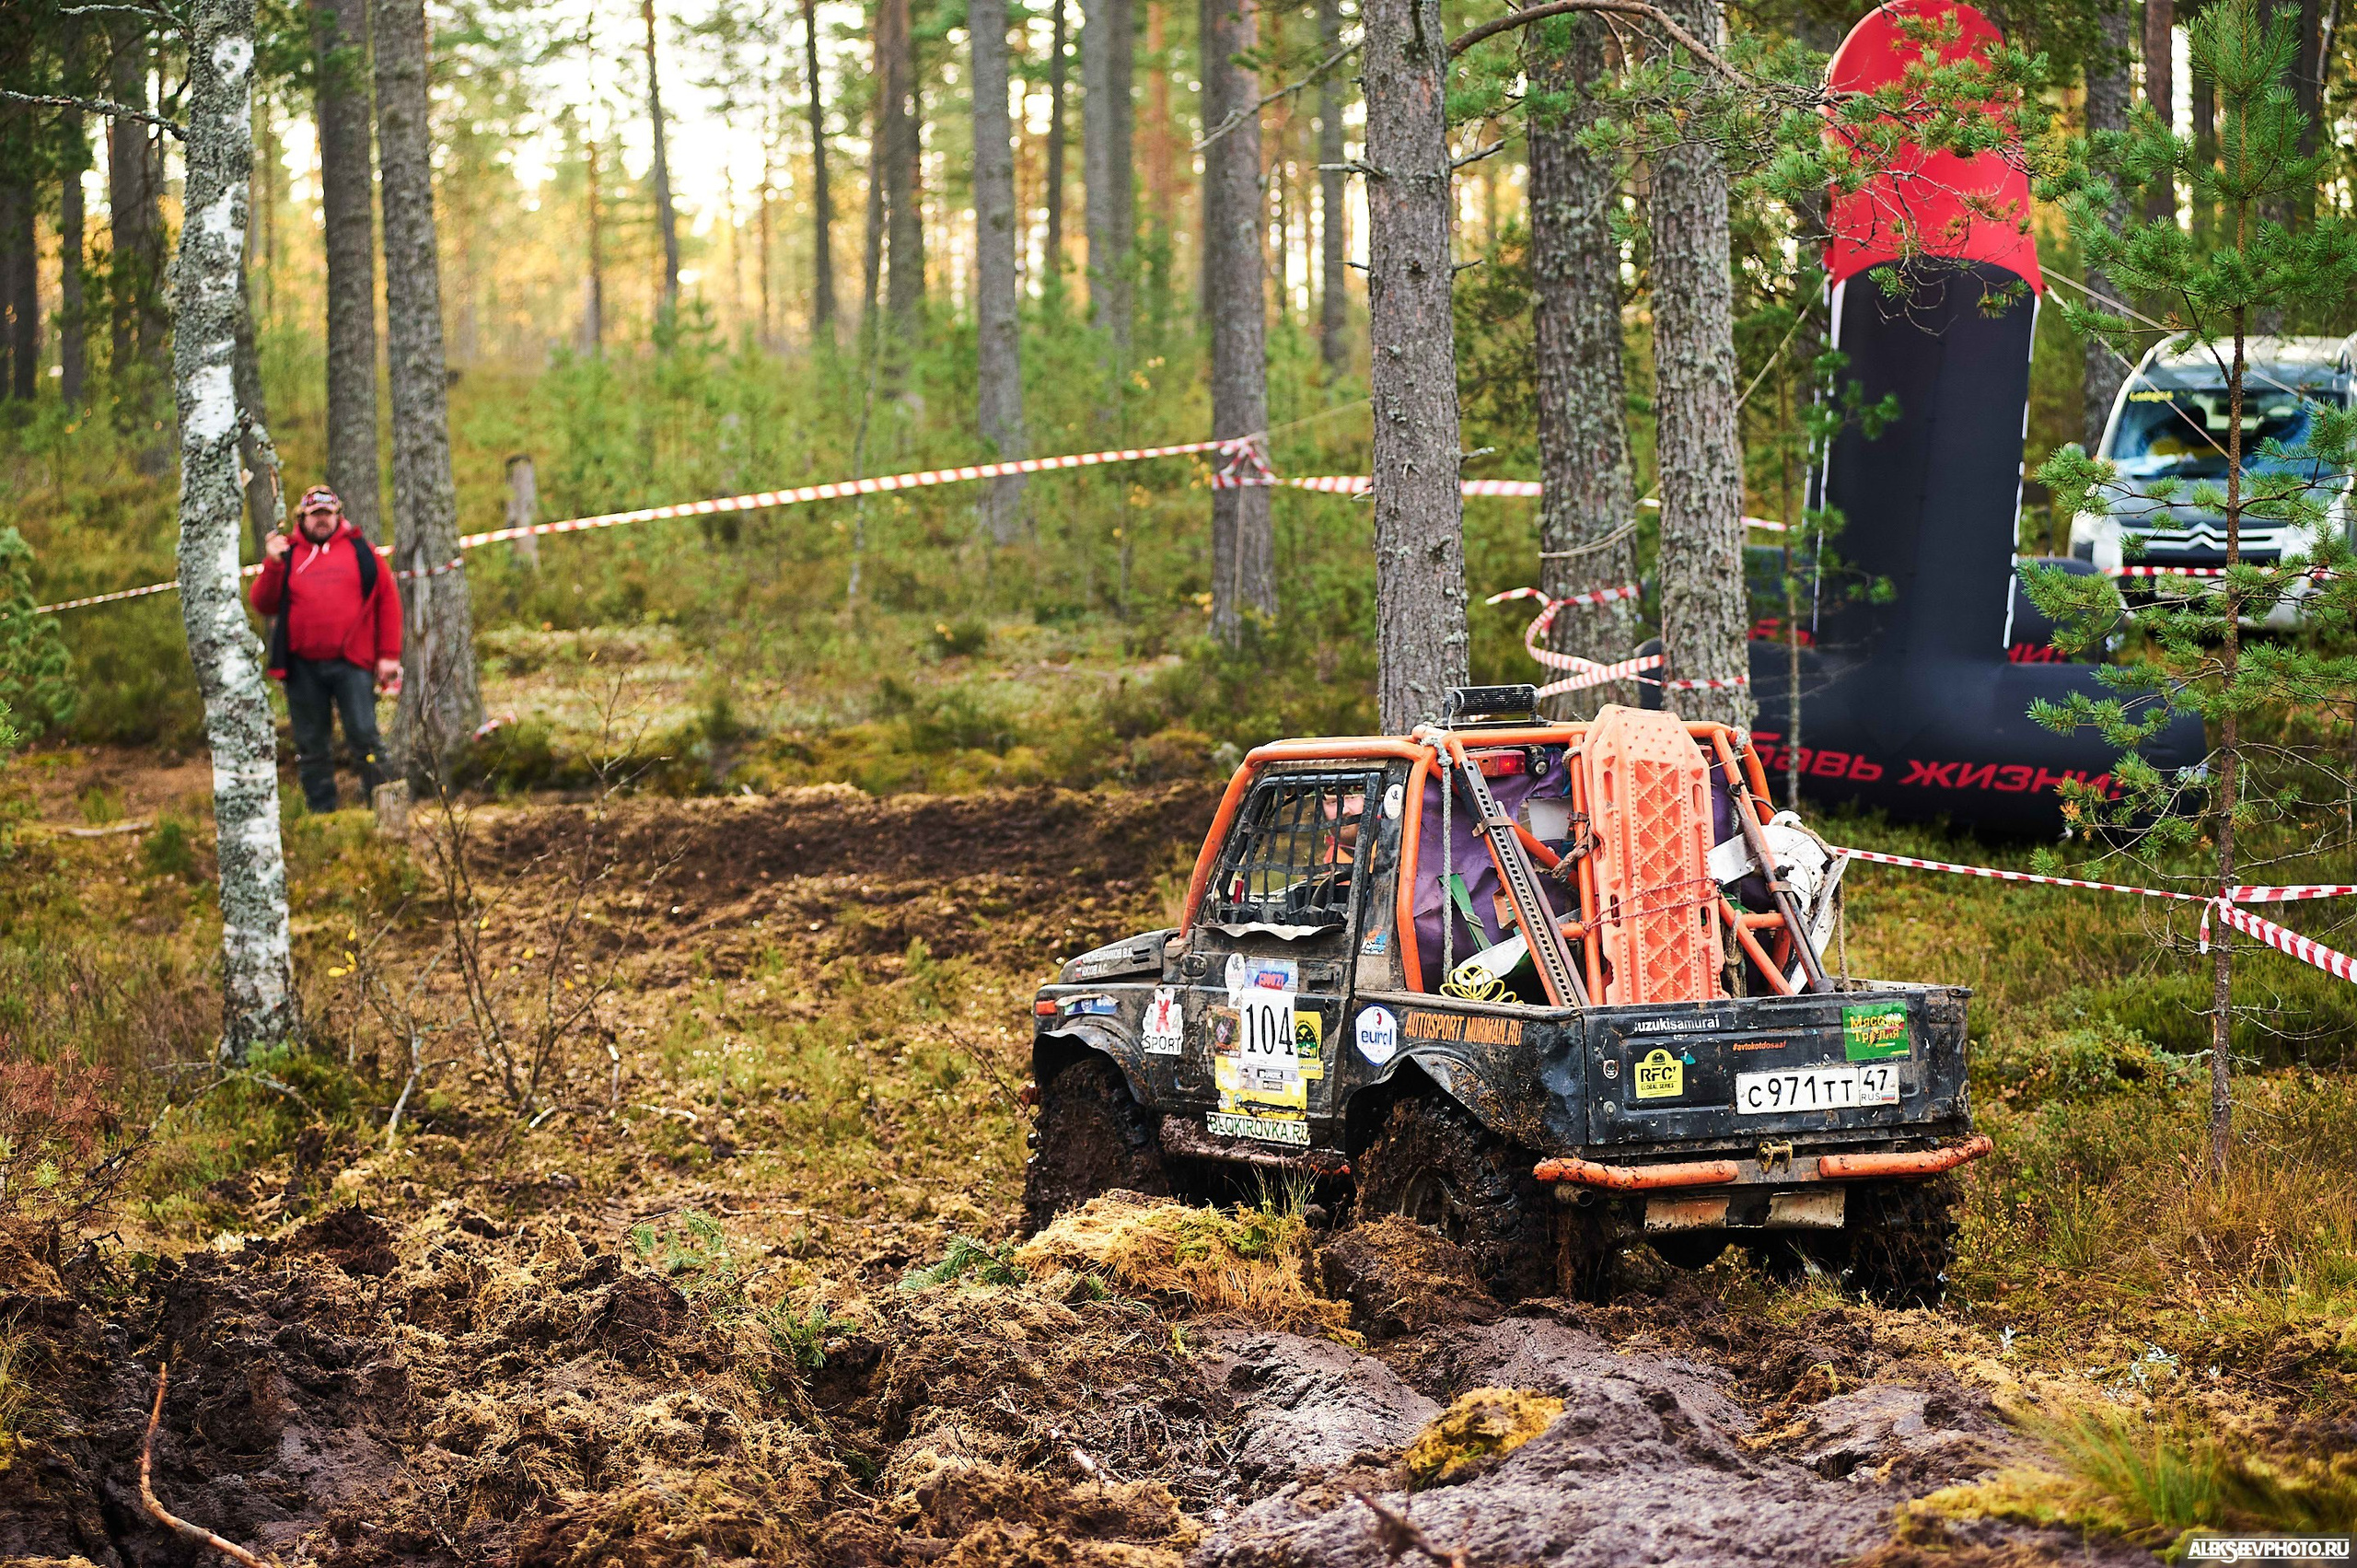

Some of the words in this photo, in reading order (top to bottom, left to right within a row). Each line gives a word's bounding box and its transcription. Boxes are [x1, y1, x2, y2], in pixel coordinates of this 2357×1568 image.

[1246, 1004, 1294, 1056] 104
[1361, 1028, 1392, 1046] eurol
[1404, 1011, 1465, 1041] AUTOSPORT
[1464, 1016, 1524, 1047] MURMAN.RU
[1851, 1028, 1900, 1044] Трлля
[1143, 1035, 1182, 1052] SPORT
[1863, 1069, 1888, 1091] 47
[1861, 1093, 1882, 1102] RUS
[1207, 1114, 1309, 1142] BLOKIROVKA.RU
